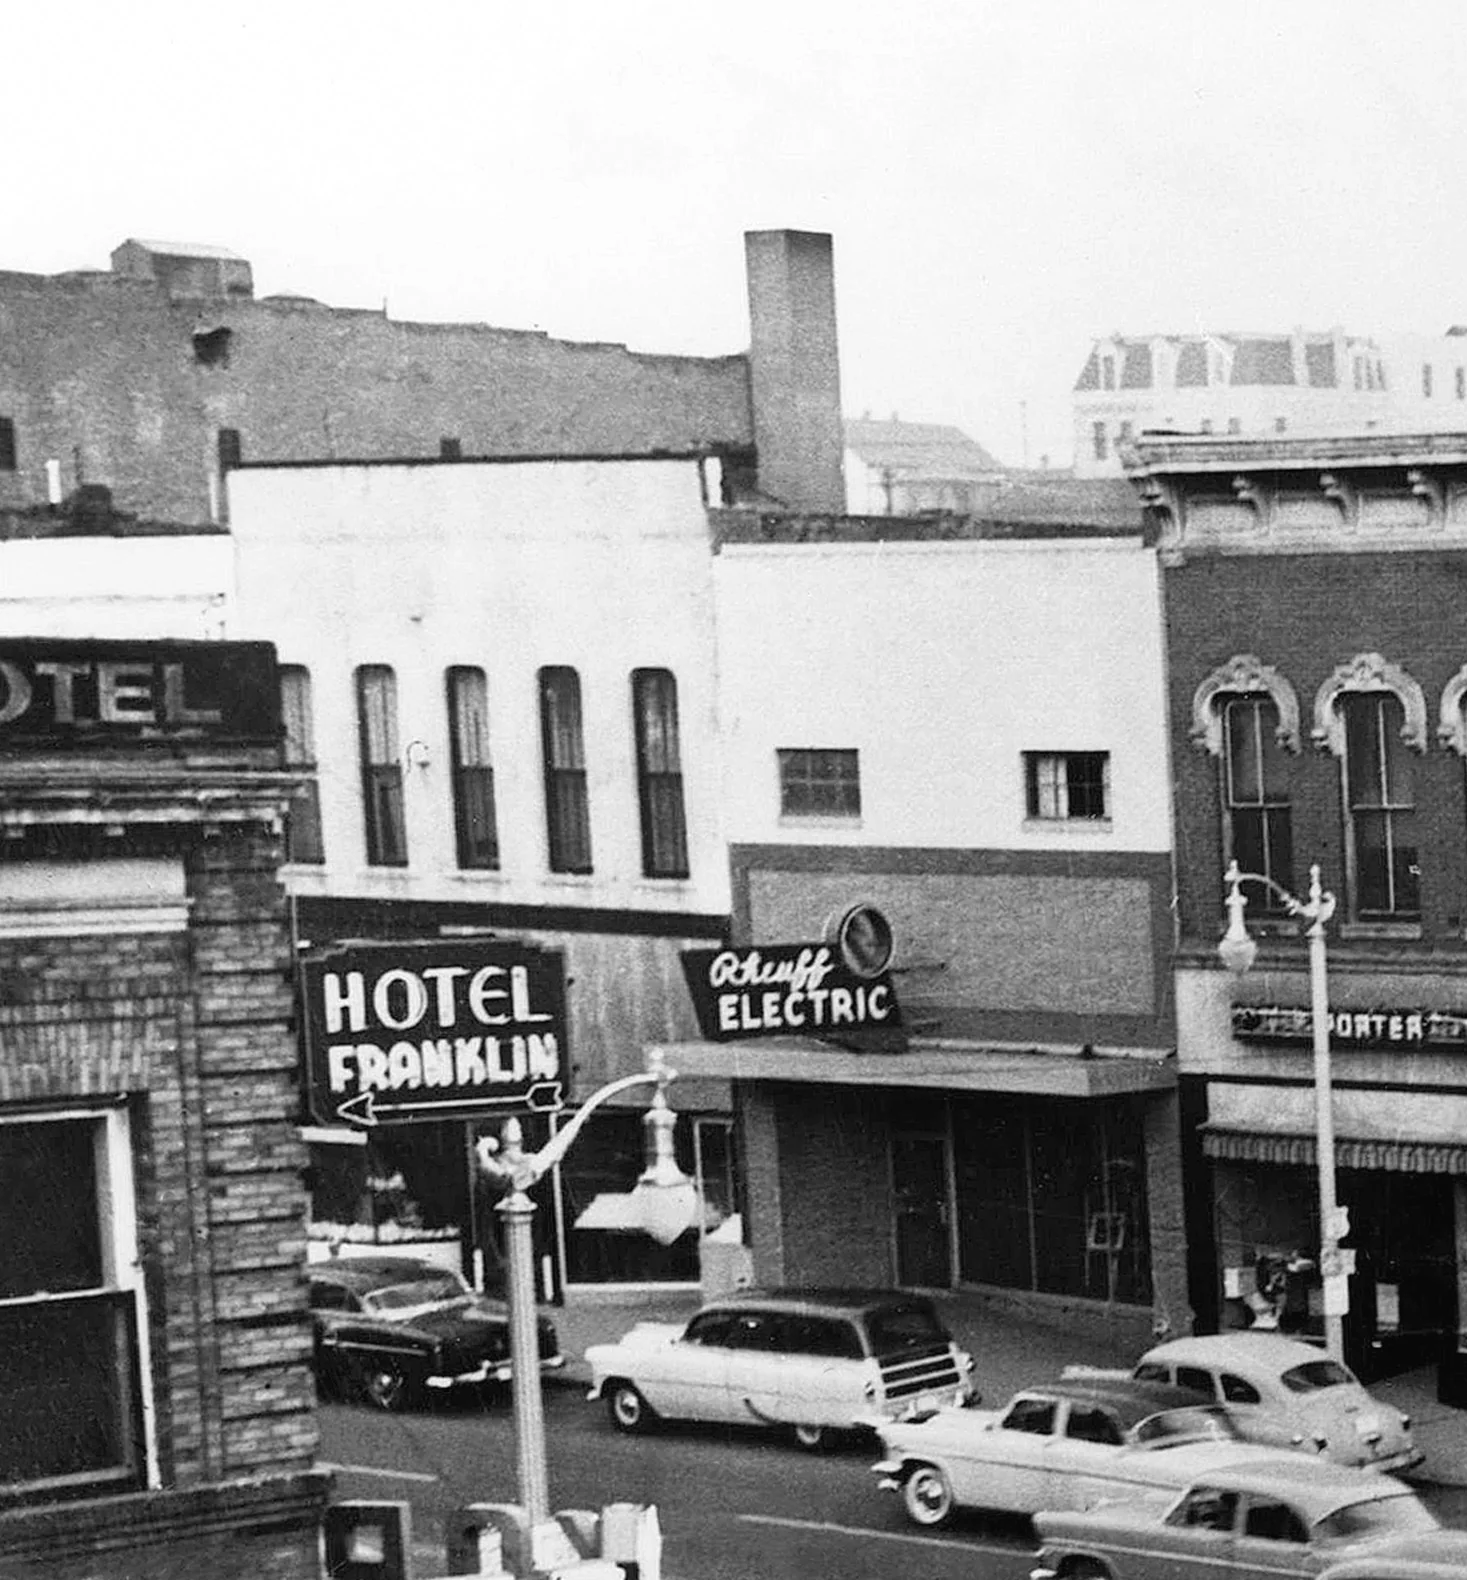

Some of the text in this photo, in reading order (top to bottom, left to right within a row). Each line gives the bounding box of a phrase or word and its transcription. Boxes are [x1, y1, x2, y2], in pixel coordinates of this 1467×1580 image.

[323, 965, 554, 1034] HOTEL
[719, 985, 889, 1031] ELECTRIC
[328, 1032, 560, 1093] FRANKLIN
